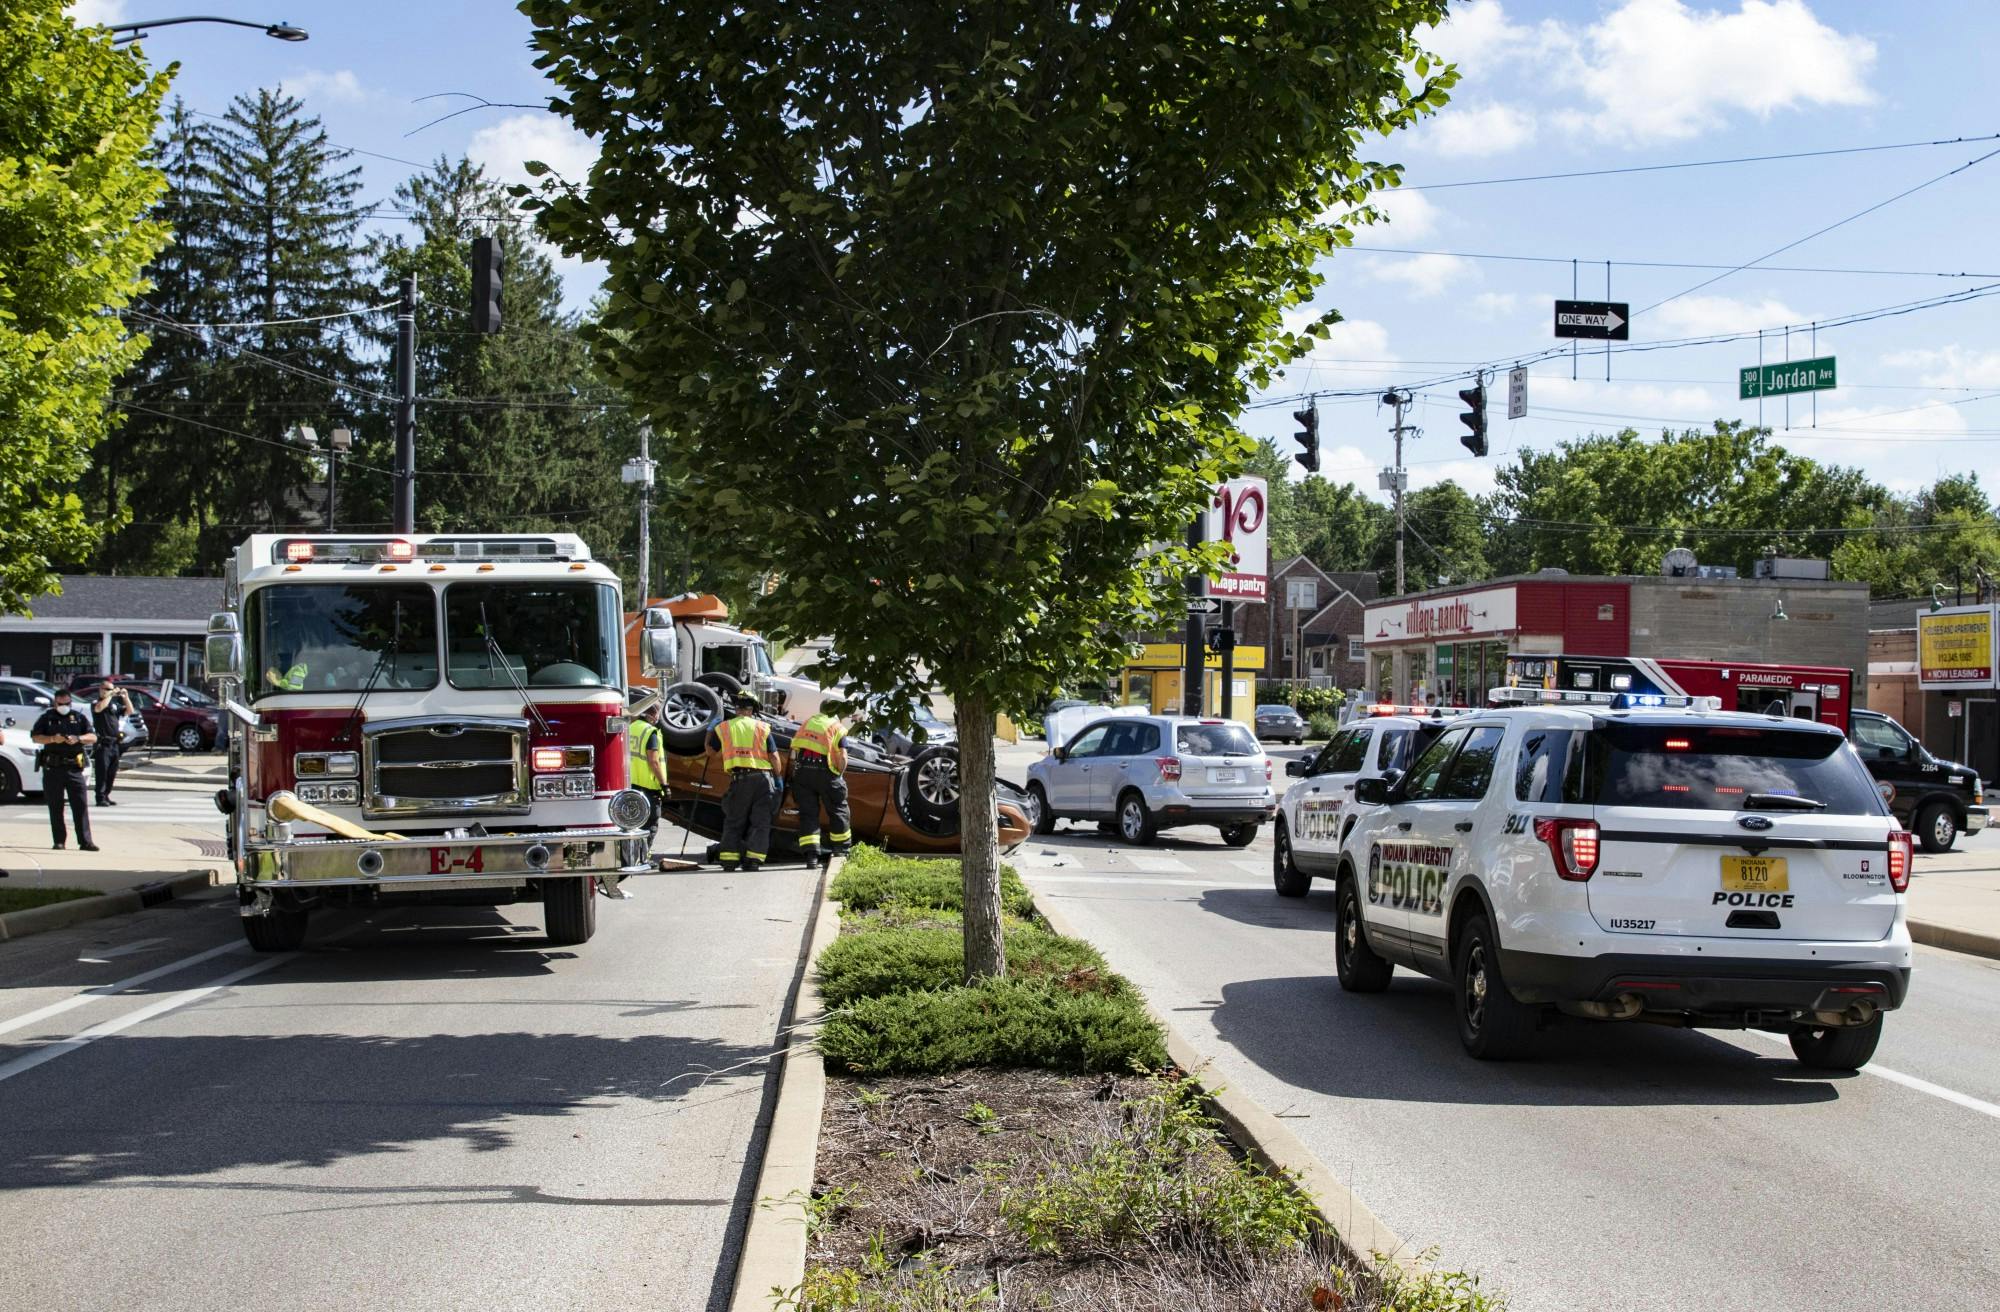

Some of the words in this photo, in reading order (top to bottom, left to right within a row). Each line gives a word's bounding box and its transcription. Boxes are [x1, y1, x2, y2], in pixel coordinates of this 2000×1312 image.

[1561, 314, 1581, 325] ONE
[1585, 314, 1607, 326] WAY
[1513, 372, 1523, 384] NO
[1743, 370, 1758, 383] 300
[1767, 367, 1816, 391] Jordan
[1819, 368, 1833, 380] Ave
[1513, 384, 1524, 393] TURN
[1239, 577, 1266, 596] pantry
[1190, 600, 1207, 609] WAY
[1406, 600, 1435, 639] village
[1438, 597, 1469, 634] pantry
[1954, 622, 1987, 633] APARTMENTS
[54, 655, 76, 666] BLACK
[1739, 673, 1793, 685] PARAMEDIC
[1932, 669, 1949, 679] NOW
[1949, 668, 1979, 678] LEASING
[1921, 763, 1939, 772] 2164
[1318, 799, 1343, 812] UNIVERSITY
[1302, 813, 1341, 840] POLICE
[1504, 814, 1530, 834] 911
[427, 845, 485, 874] E-4
[1382, 844, 1408, 863] INDIANA
[1409, 845, 1454, 868] UNIVERSITY
[1741, 866, 1768, 882] 8120
[1380, 864, 1449, 913] POLICE
[1712, 891, 1795, 908] POLICE
[1610, 919, 1656, 930] IU35217
